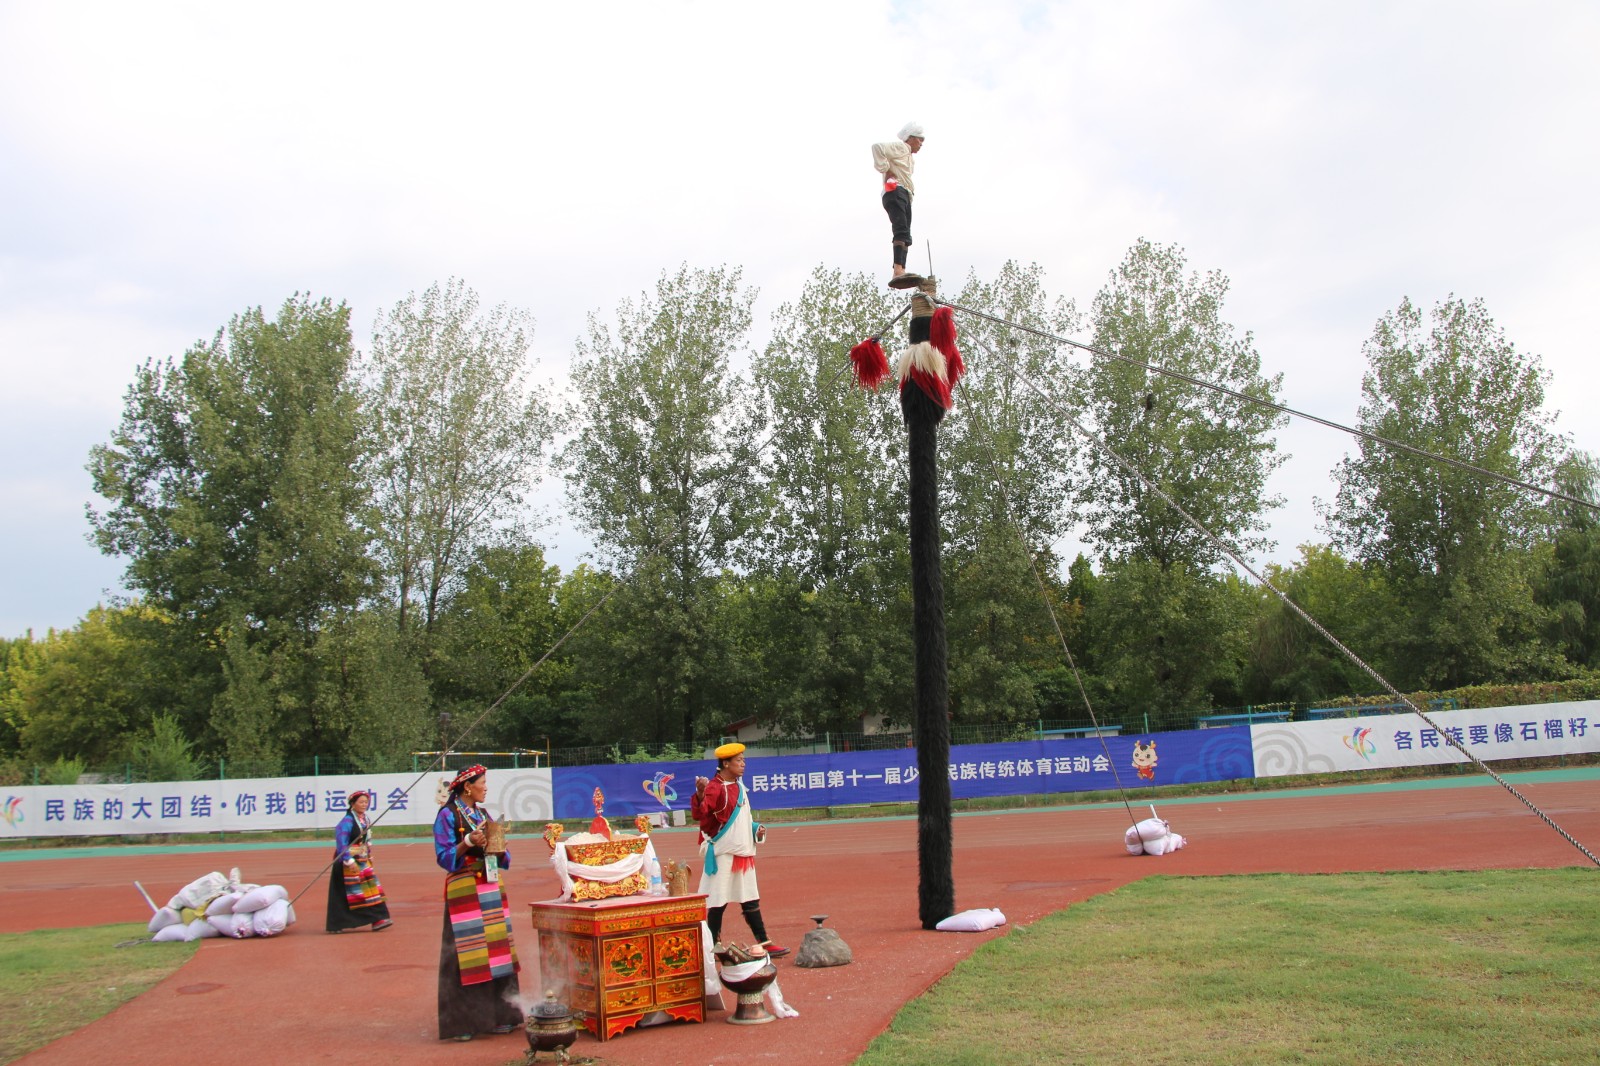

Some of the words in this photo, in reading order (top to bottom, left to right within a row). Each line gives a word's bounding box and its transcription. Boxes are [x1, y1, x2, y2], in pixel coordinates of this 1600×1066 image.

[738, 754, 1110, 793] 民共和国第十一届少民族传统体育运动会
